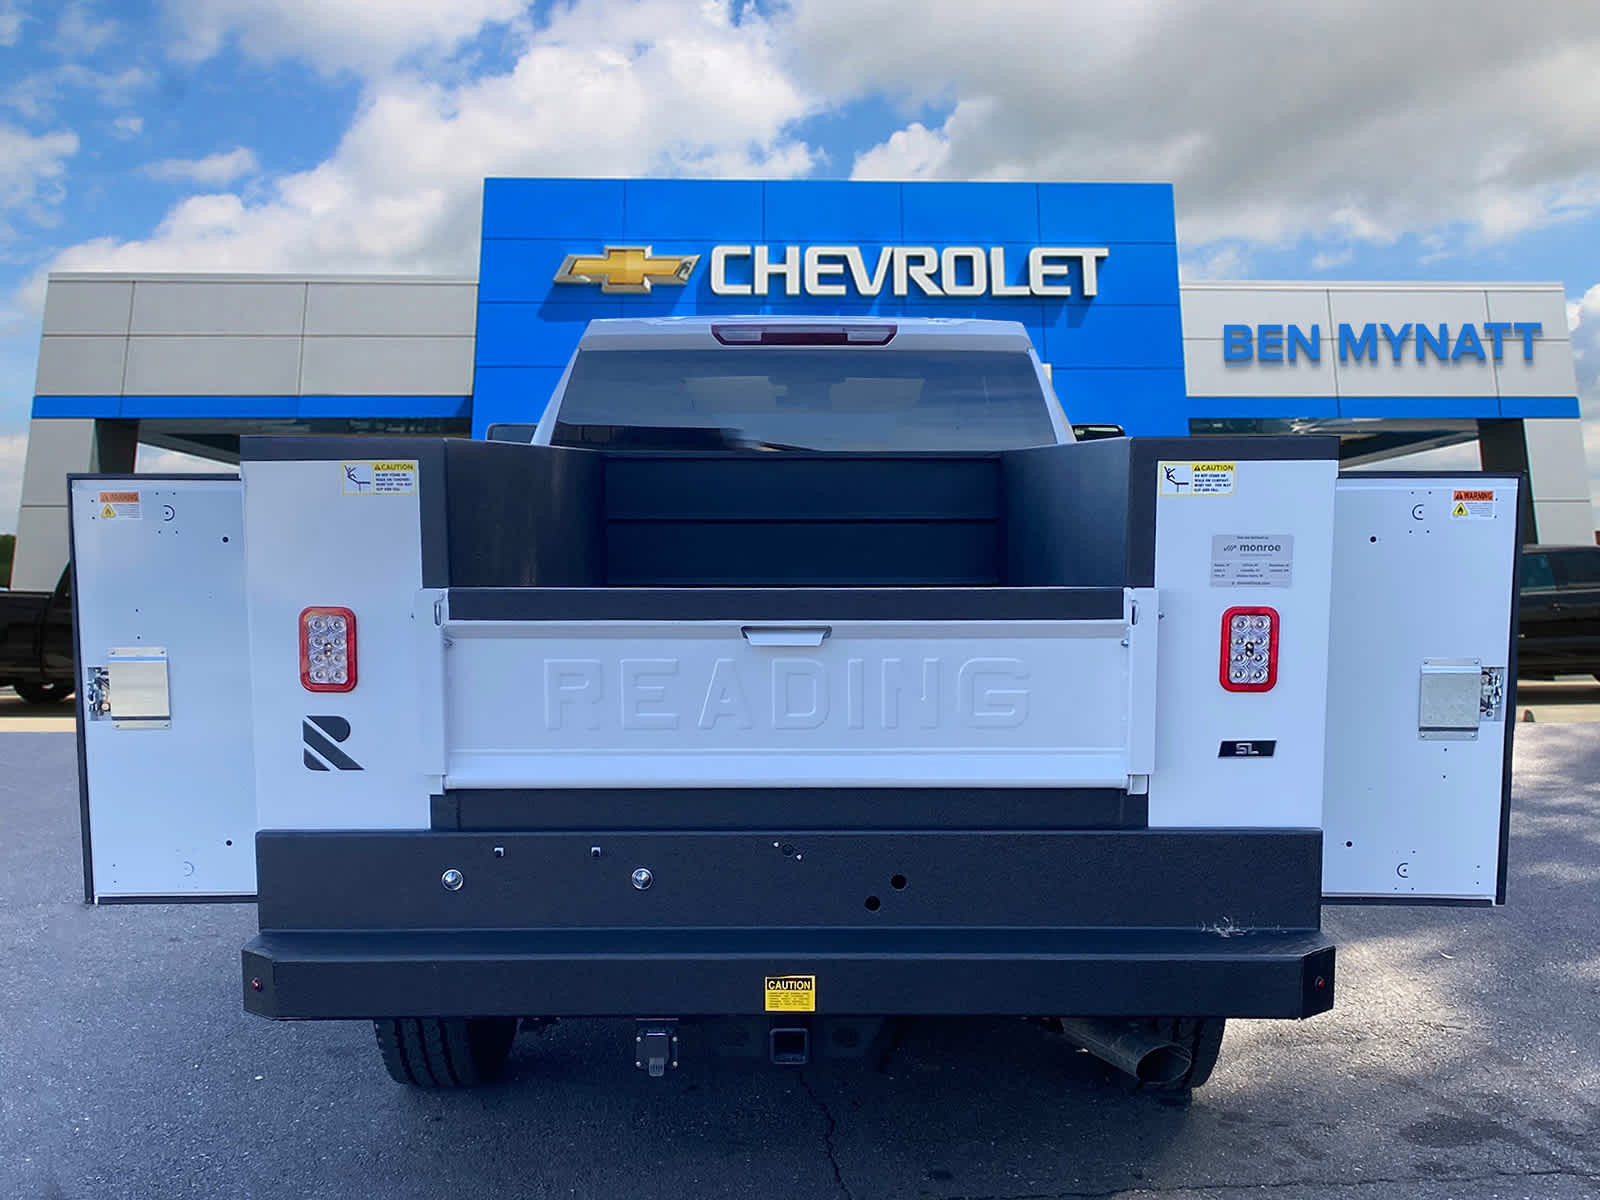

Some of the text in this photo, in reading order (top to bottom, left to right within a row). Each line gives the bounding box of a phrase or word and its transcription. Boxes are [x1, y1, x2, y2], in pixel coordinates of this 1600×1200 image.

[709, 245, 1109, 297] CHEVROLET
[1223, 322, 1543, 364] BEN MYNATT
[381, 463, 414, 471] CAUTION
[1201, 464, 1234, 472] CAUTION
[1463, 491, 1492, 499] WARNING
[1239, 544, 1281, 552] monroe
[542, 657, 1032, 730] READING
[1235, 743, 1259, 754] SL
[768, 980, 811, 989] CAUTION
